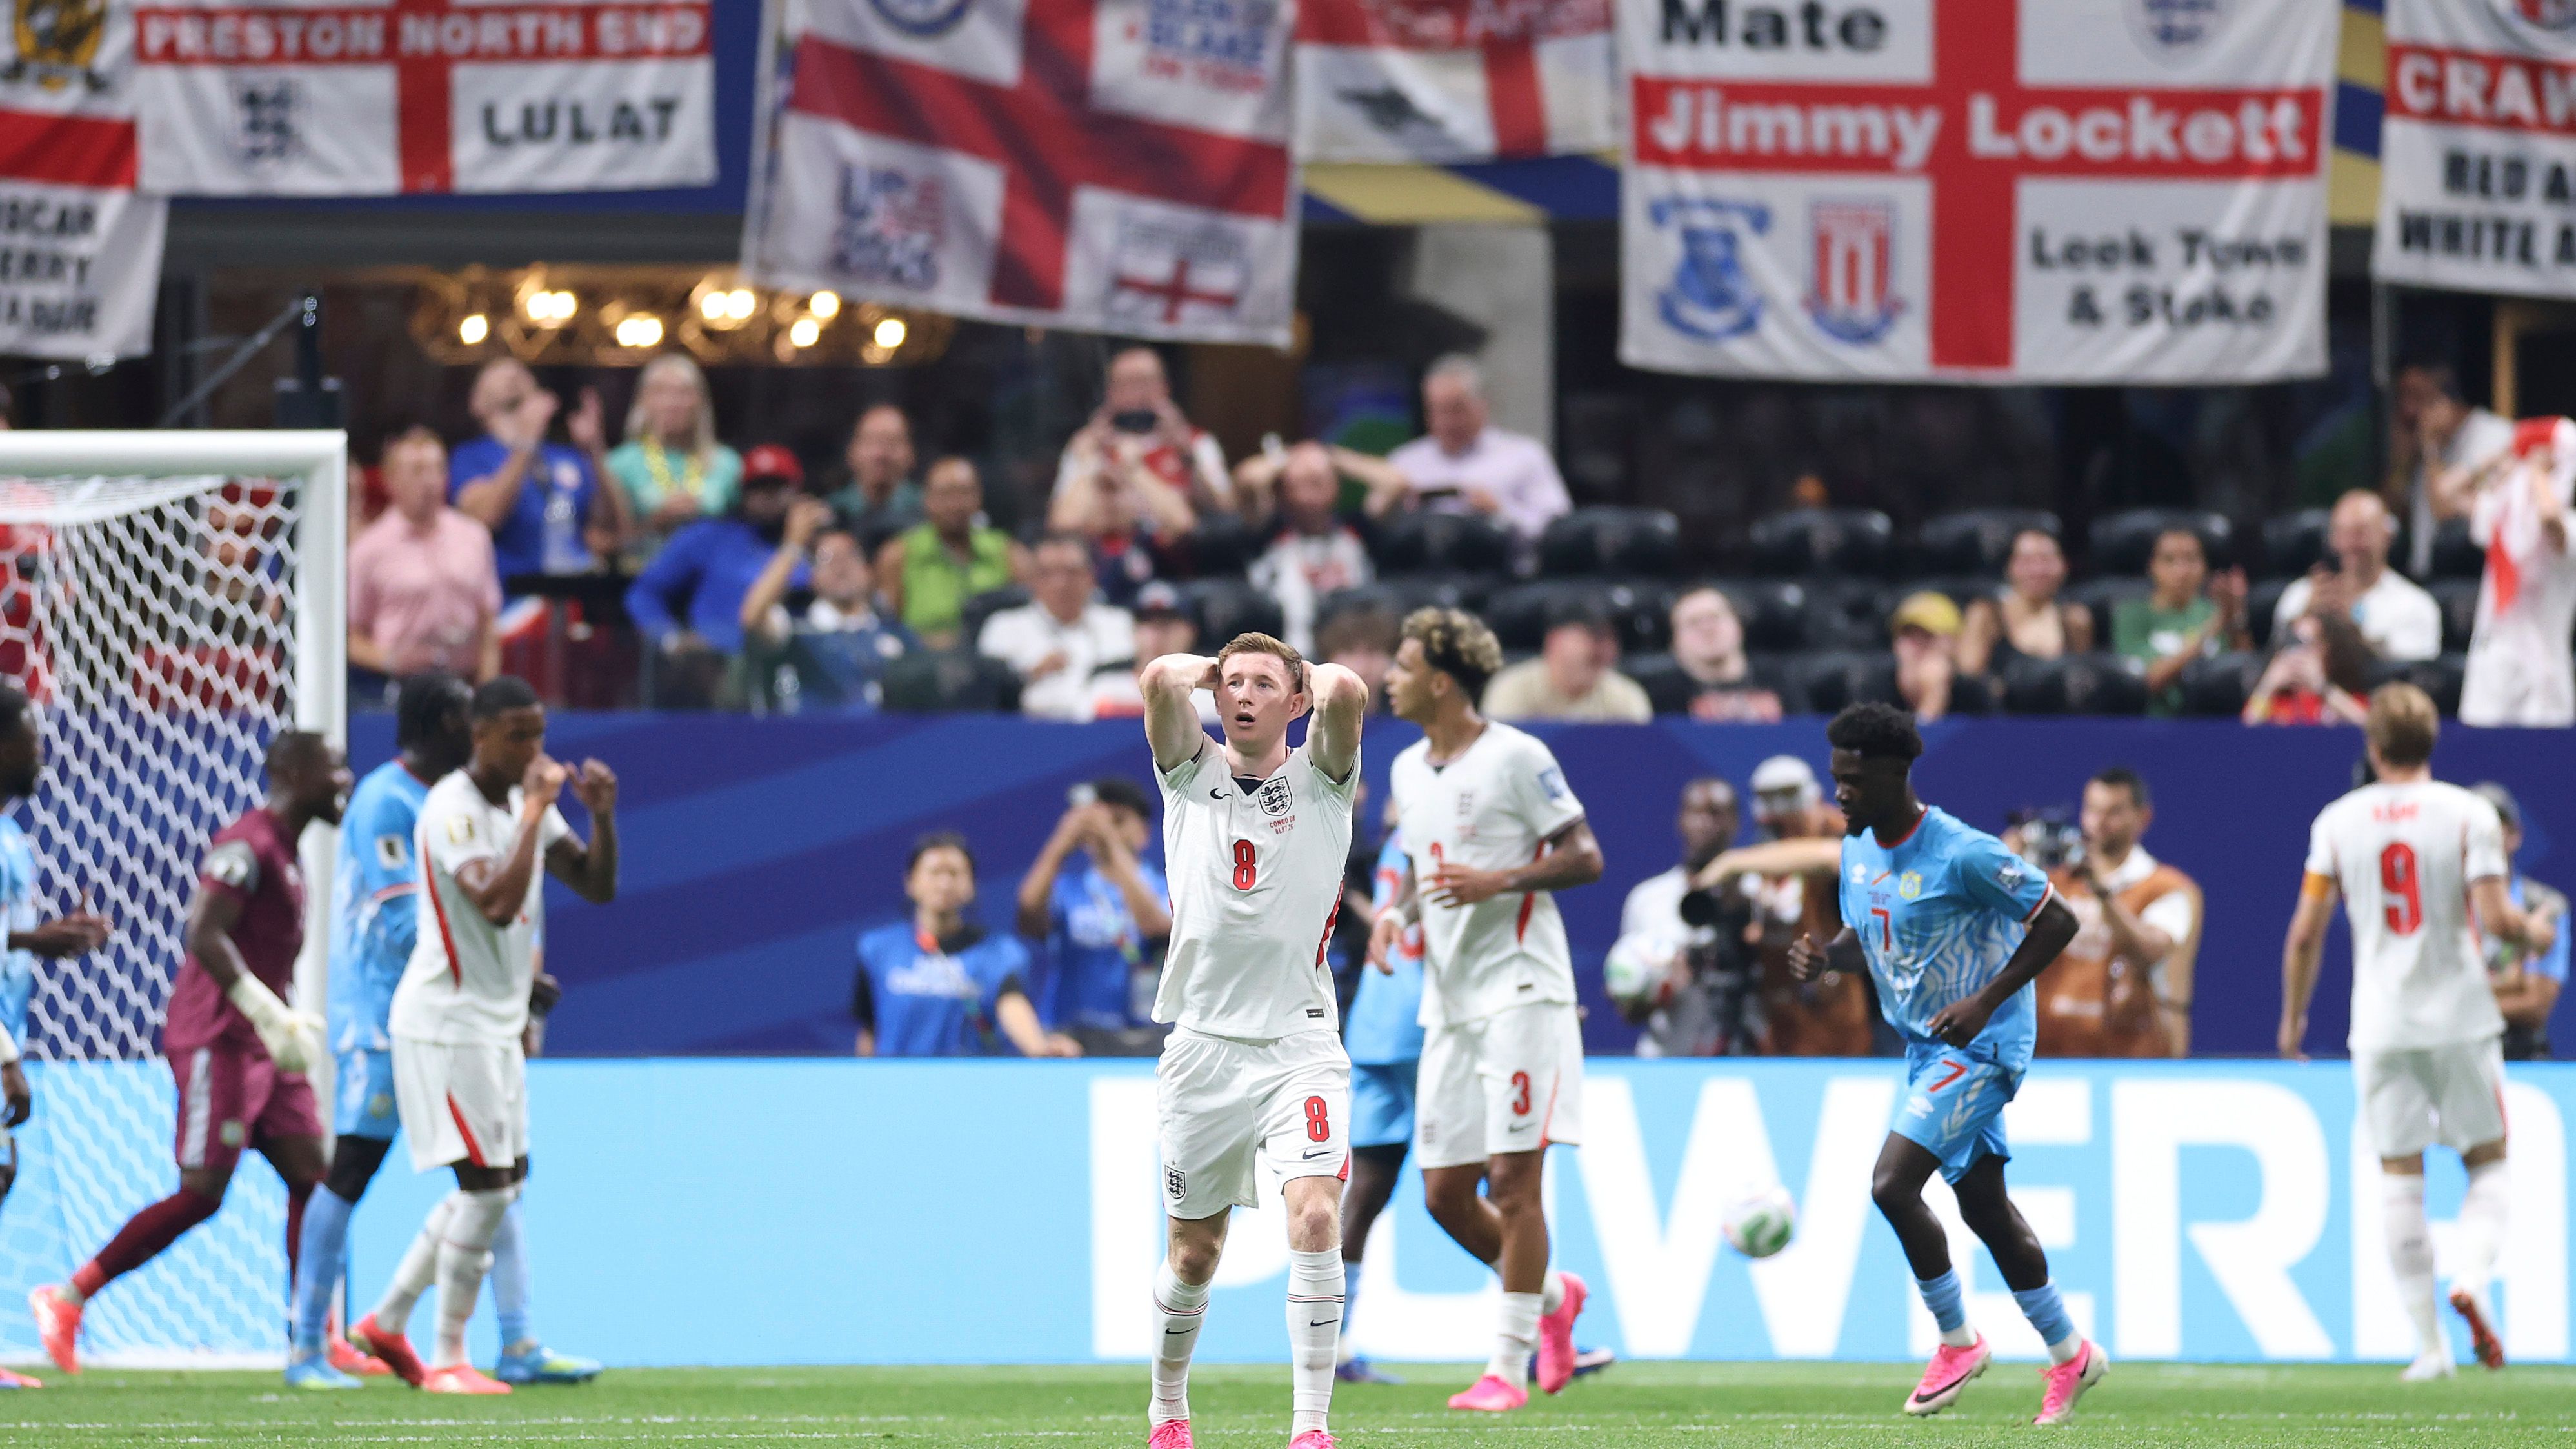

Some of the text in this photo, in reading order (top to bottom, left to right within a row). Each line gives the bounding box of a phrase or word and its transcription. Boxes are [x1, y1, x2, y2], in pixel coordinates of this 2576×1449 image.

[143, 7, 706, 58] PRESTON NORTH END
[1661, 0, 1888, 52] Mate
[483, 97, 680, 145] LULAT
[1653, 87, 2305, 170] Jimmy Lockett
[2068, 284, 2104, 325] &
[1270, 817, 1289, 828] CONGO
[1233, 839, 1256, 891] 8
[2380, 841, 2423, 936] 9
[1871, 907, 1891, 952] 7
[1512, 1071, 1531, 1116] 3
[1927, 1059, 1968, 1092] 7
[1304, 1095, 1330, 1142] 8
